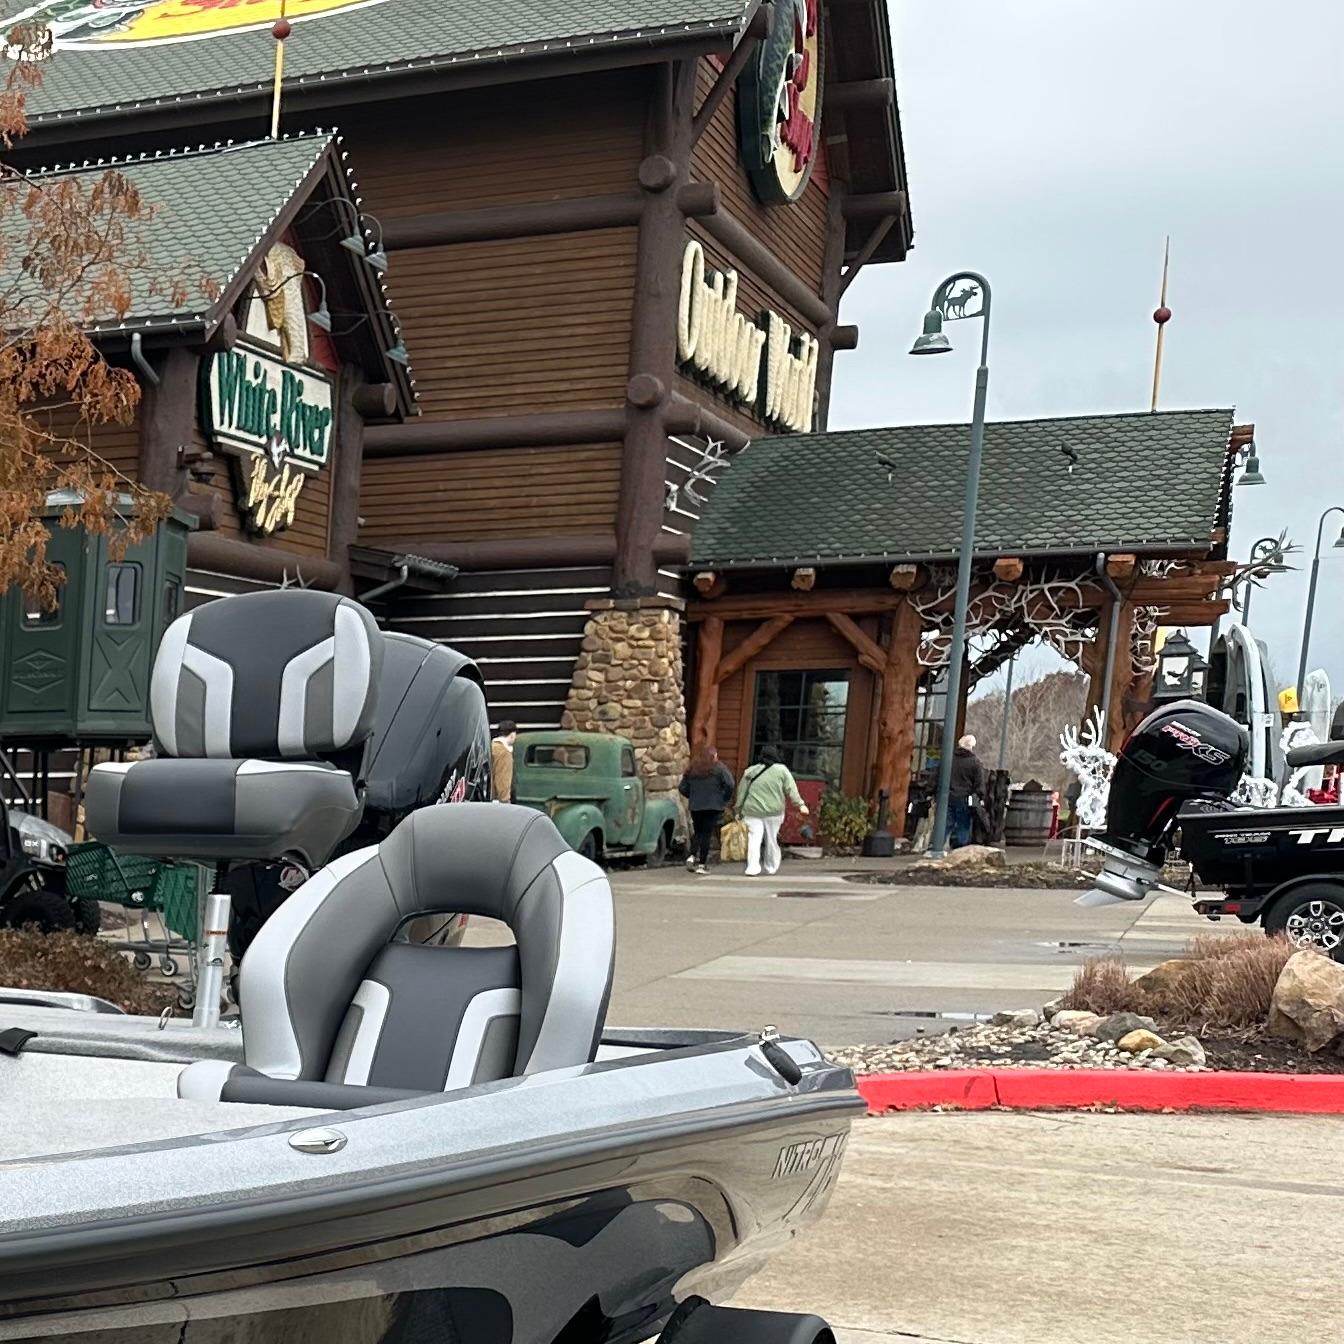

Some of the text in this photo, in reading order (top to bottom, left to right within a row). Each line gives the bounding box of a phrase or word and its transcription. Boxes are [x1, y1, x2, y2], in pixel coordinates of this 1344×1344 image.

[216, 351, 332, 456] White River
[678, 240, 819, 433] Outdoor World
